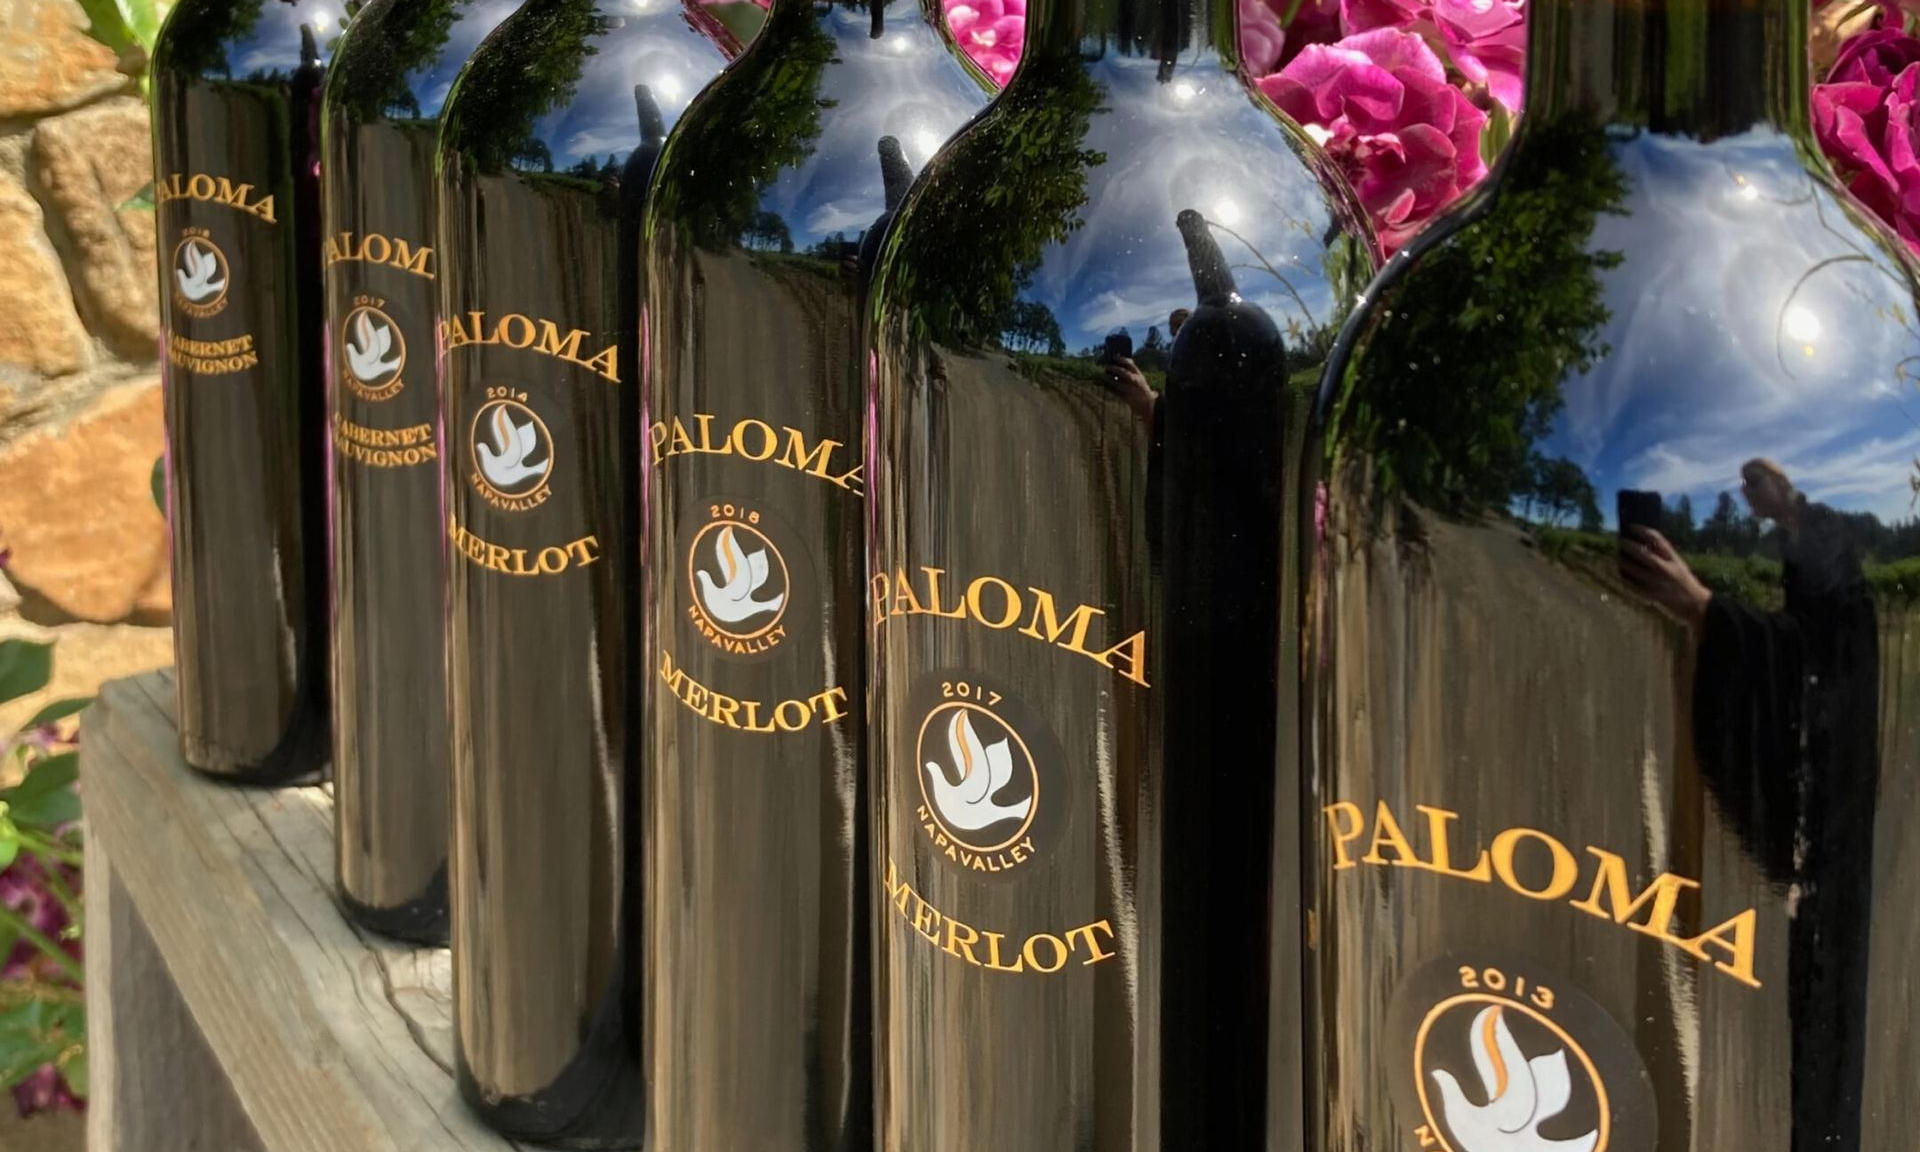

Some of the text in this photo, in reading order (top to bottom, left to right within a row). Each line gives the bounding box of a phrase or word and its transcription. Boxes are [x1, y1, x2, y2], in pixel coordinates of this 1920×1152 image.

[156, 173, 278, 224] ALOMA
[439, 311, 622, 384] PALOMA
[448, 511, 600, 576] MERLOT
[710, 504, 760, 524] 2018
[871, 566, 1151, 688] PALOMA
[660, 649, 849, 733] MERLOT
[942, 682, 1002, 705] 2017
[885, 858, 1116, 974] MERLOT
[1322, 799, 1762, 989] PALOMA
[1459, 965, 1554, 1009] 2013
